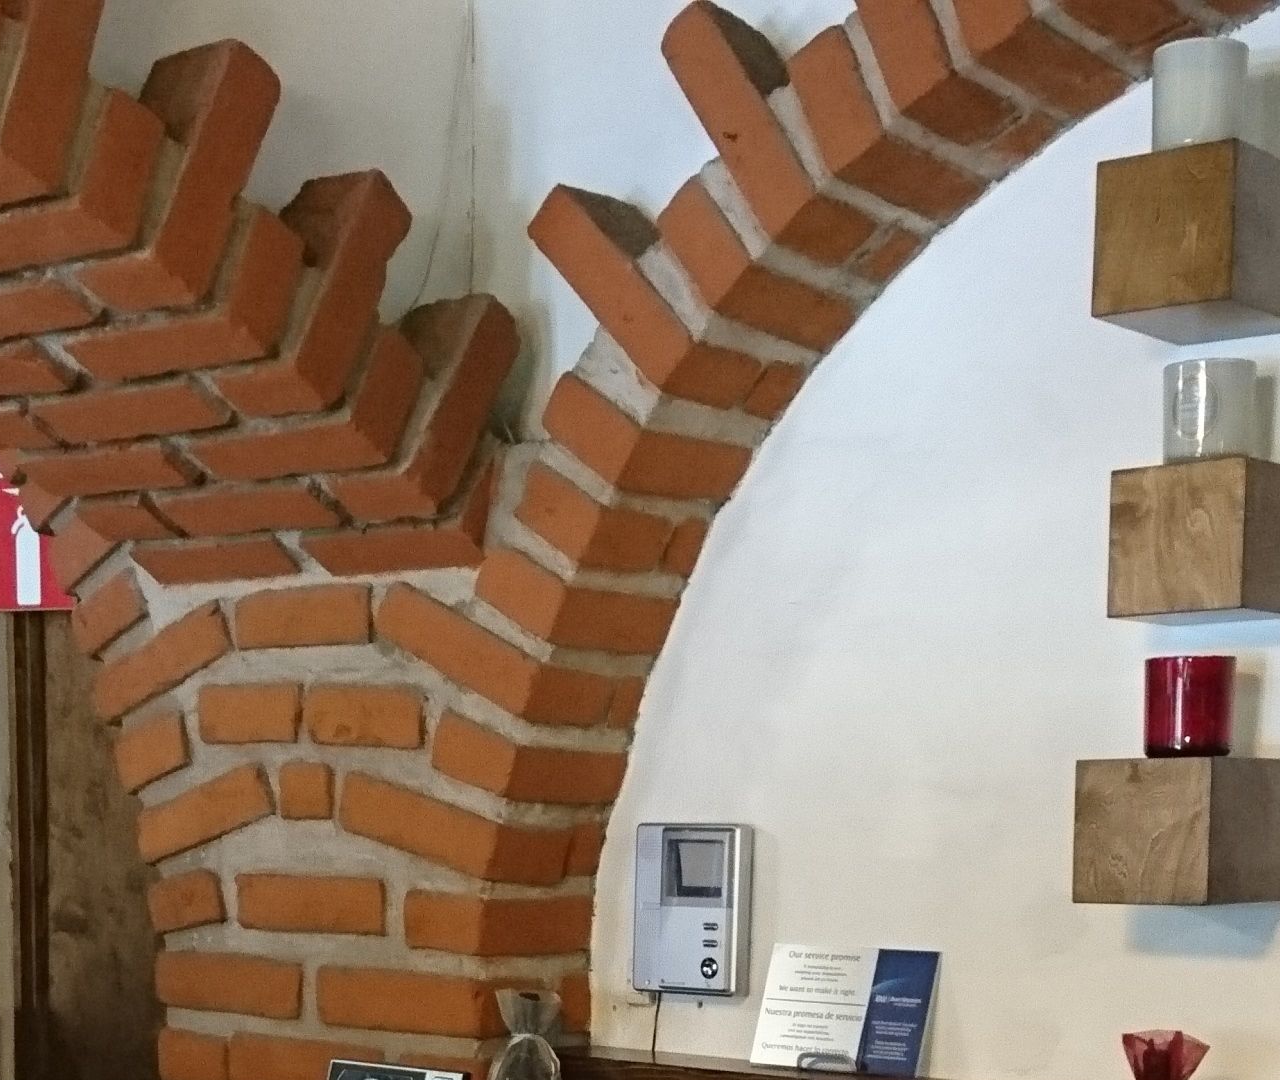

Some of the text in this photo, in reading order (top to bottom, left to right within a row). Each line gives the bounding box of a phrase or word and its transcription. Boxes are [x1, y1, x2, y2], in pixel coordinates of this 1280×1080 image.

[789, 950, 861, 962] Our service promise
[790, 985, 806, 993] want
[765, 1007, 863, 1022] Nuestra promesa de servicio
[761, 1041, 793, 1052] Queremos
[795, 1044, 812, 1053] hacer
[814, 1045, 820, 1054] lo
